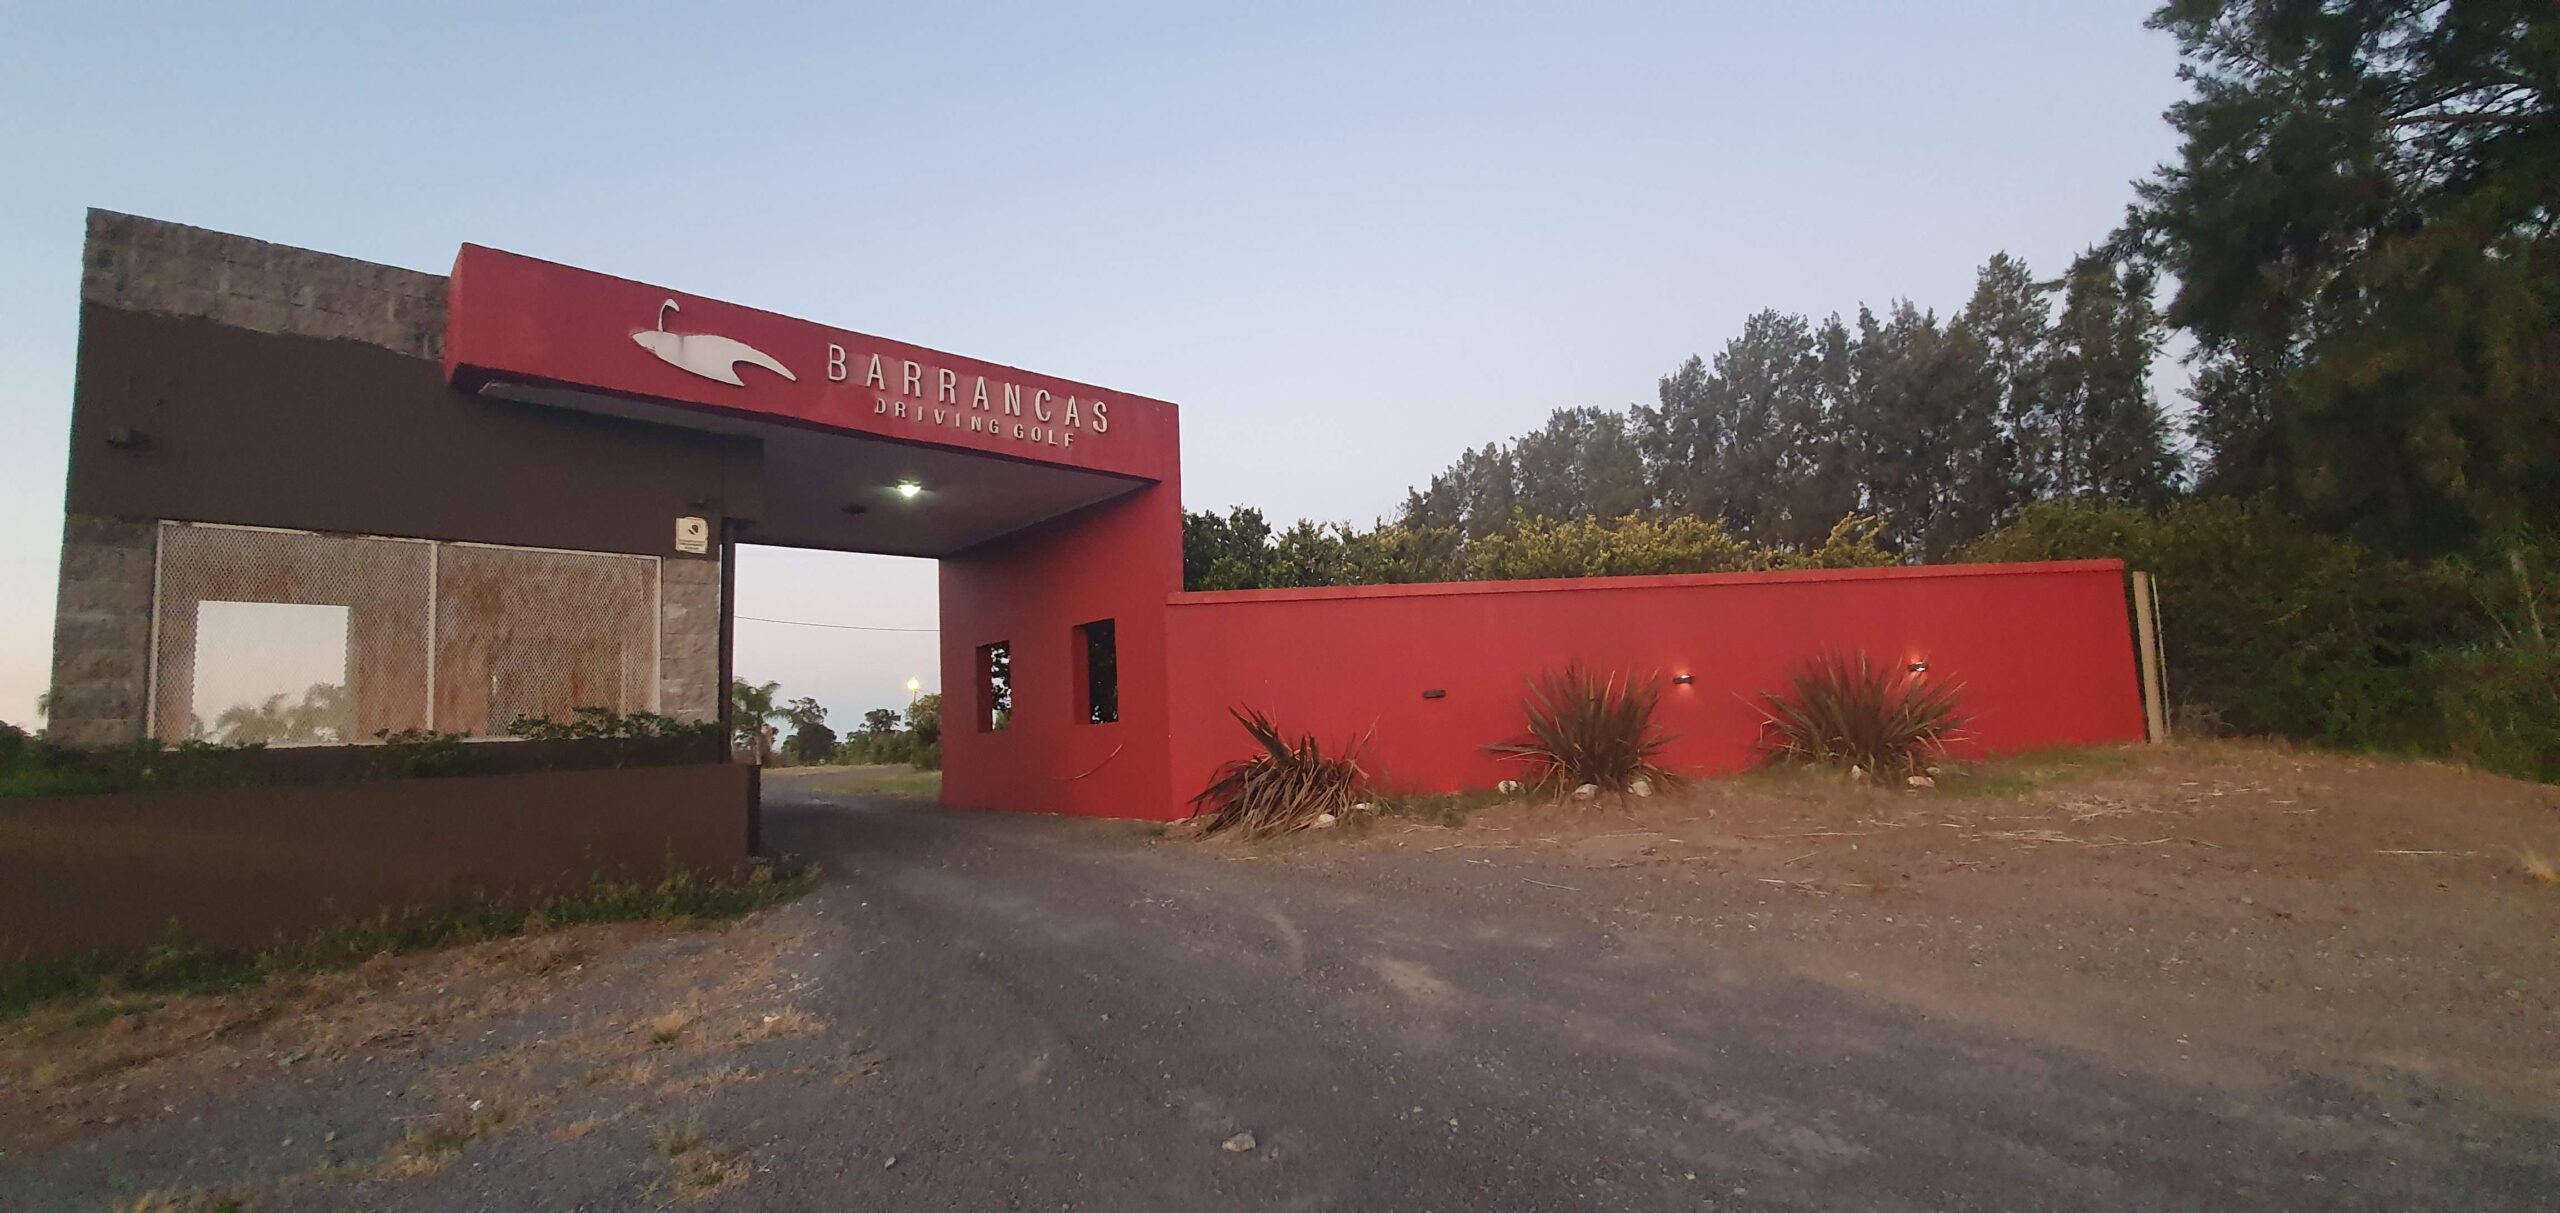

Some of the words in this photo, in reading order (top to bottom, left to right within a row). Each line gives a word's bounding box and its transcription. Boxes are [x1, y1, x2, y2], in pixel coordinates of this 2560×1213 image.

[827, 343, 1109, 433] BARRANCAS
[874, 398, 999, 434] DRIVING
[1013, 423, 1075, 447] GOLF
